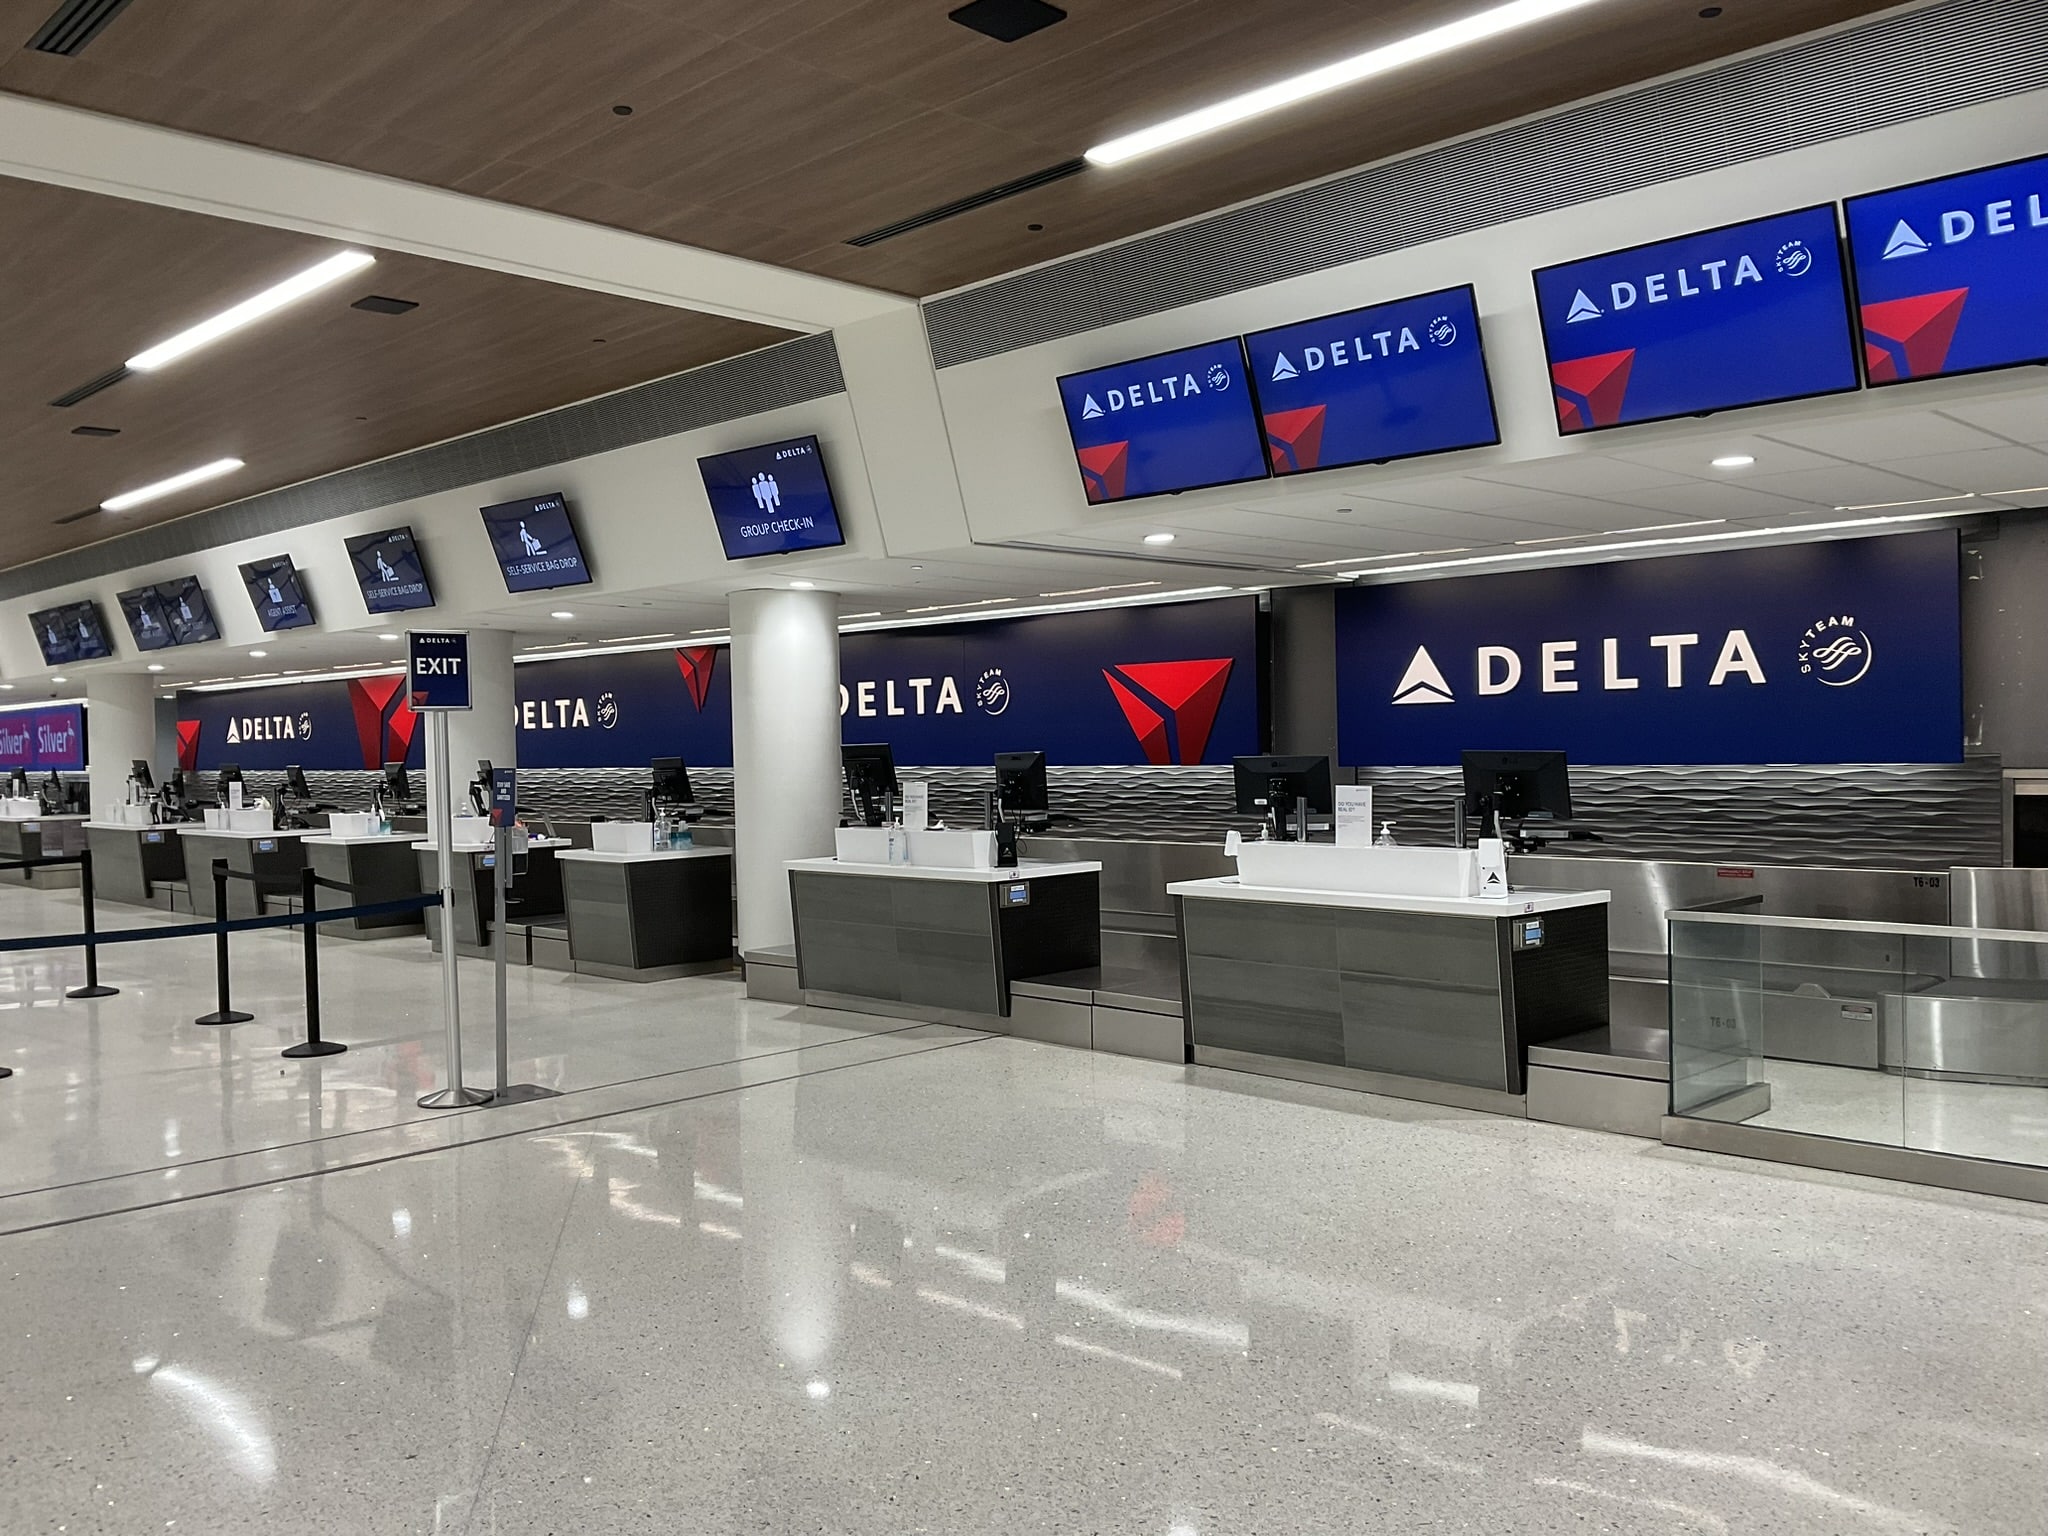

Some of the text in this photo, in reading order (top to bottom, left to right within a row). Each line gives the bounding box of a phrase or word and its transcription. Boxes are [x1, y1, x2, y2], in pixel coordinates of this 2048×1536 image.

[1610, 254, 1764, 311] DELTA
[1303, 326, 1421, 372] DELTA
[1106, 373, 1202, 412] DELTA
[781, 446, 806, 458] DELTA
[740, 515, 815, 538] GROUP CHECK-IN
[506, 556, 578, 577] SELF-SERVICE BAG DROP
[1798, 615, 1855, 674] SKYTEAM
[416, 656, 462, 675] EXIT
[1477, 629, 1767, 696] DELTA
[242, 714, 296, 741] DELTA
[514, 697, 590, 730] ELTA
[38, 723, 67, 754] Silver
